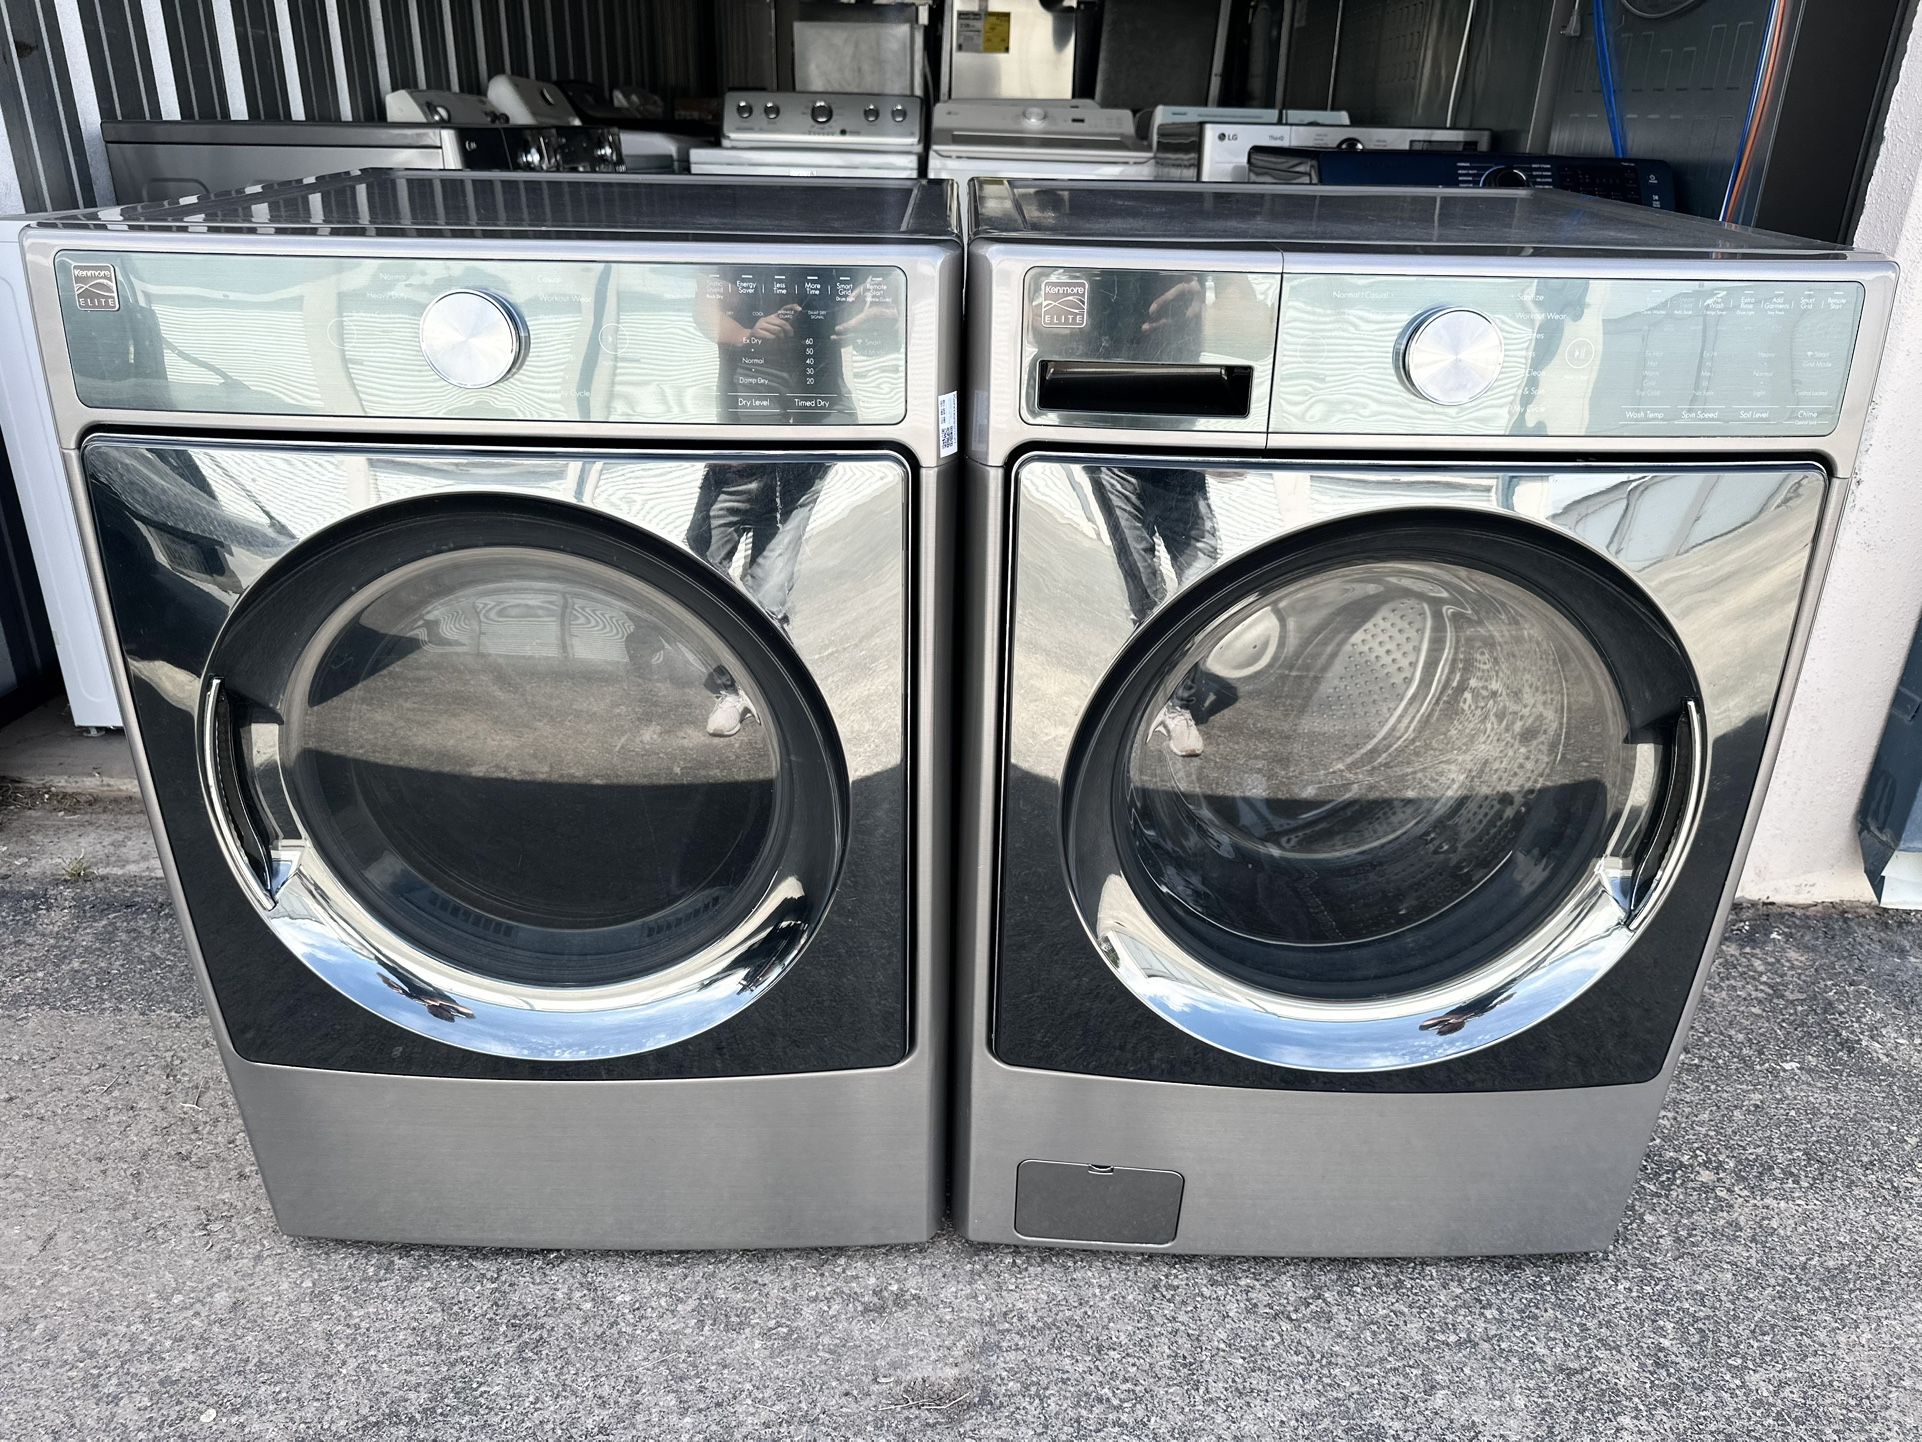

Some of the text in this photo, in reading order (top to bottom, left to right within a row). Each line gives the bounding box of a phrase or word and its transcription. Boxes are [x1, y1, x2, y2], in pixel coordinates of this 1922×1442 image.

[74, 268, 111, 278] Kenmore
[736, 281, 757, 289] Energy
[1045, 285, 1085, 294] Kenmore
[79, 298, 116, 307] ELITE
[1044, 314, 1083, 323] ELITE
[750, 337, 763, 345] Dry
[741, 357, 765, 365] Normal
[739, 377, 769, 385] Damp Dry
[806, 377, 815, 385] 20
[738, 398, 770, 406] Dry Level
[794, 399, 830, 407] Timed Dry
[1625, 410, 1664, 420] Wash Temp
[1681, 410, 1718, 420] Spin Speed
[1739, 410, 1769, 419] Soil Level
[1797, 410, 1818, 418] Chime
